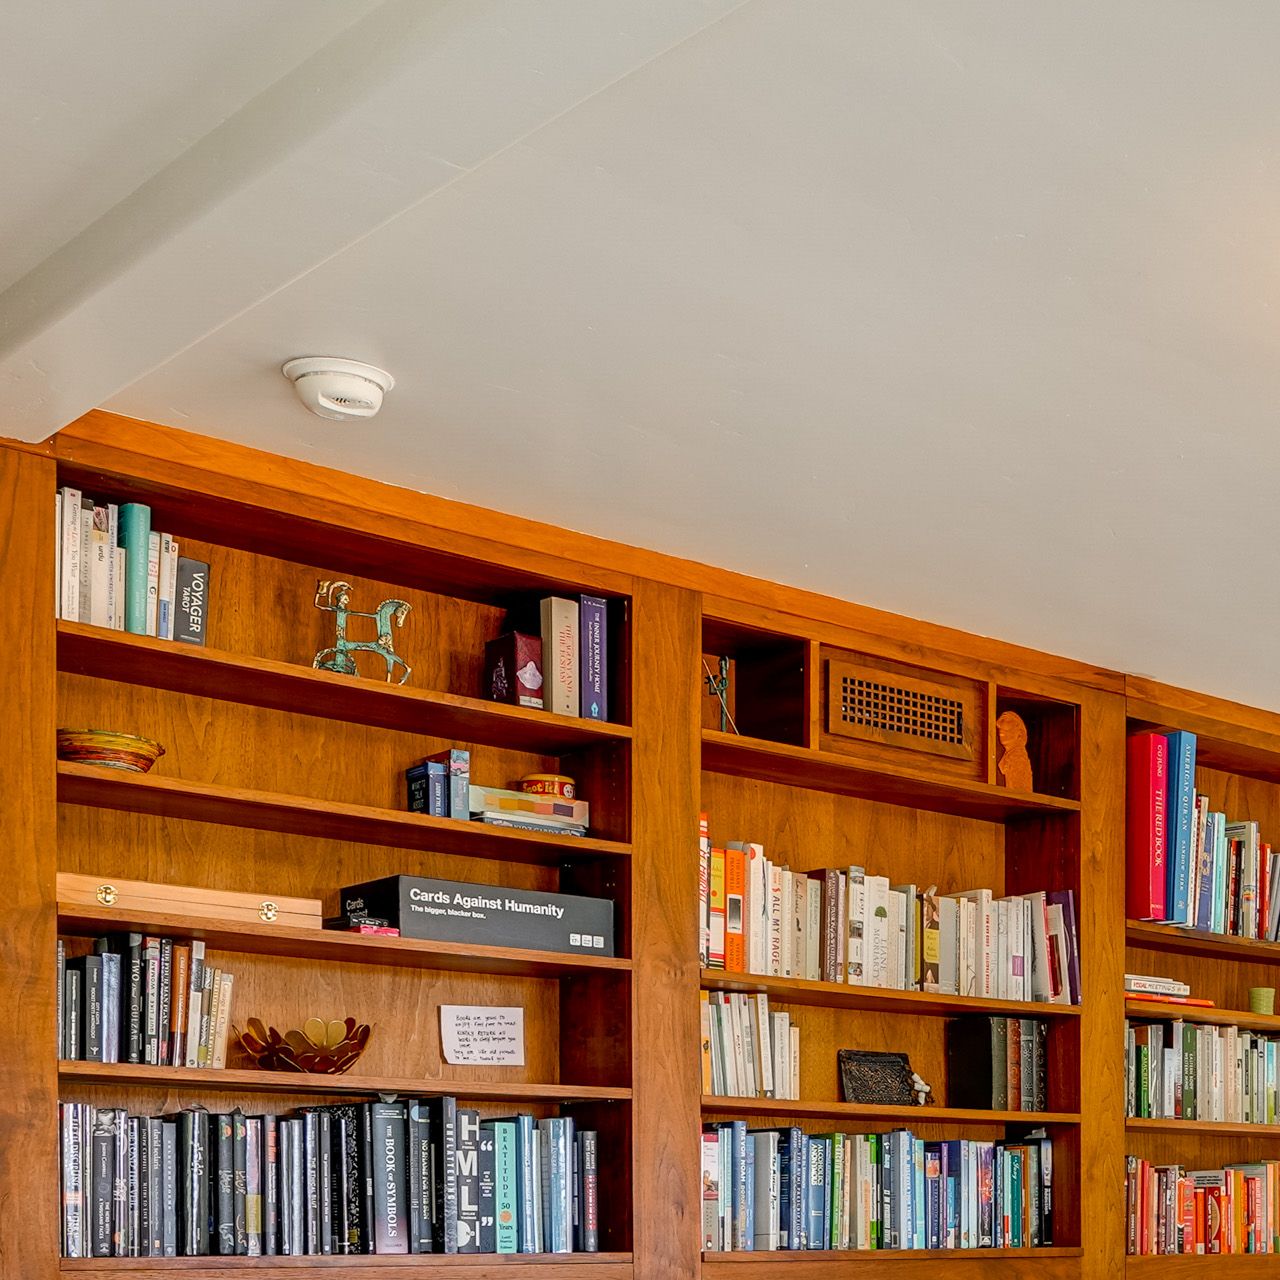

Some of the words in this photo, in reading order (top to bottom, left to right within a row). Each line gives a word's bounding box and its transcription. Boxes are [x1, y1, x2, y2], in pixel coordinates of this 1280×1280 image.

[182, 587, 190, 613] TAROT
[189, 572, 205, 633] VOYAGER
[593, 623, 601, 643] INNER
[1183, 744, 1192, 793] AMERICAN
[1155, 789, 1163, 812] THE
[345, 898, 364, 911] Cards
[409, 887, 450, 904] Cards
[453, 892, 503, 911] Against
[505, 899, 565, 919] Humanity
[410, 904, 424, 913] The
[424, 905, 447, 916] bigger,
[447, 908, 470, 918] blacker
[470, 911, 487, 920] box.
[772, 895, 780, 914] ALL
[772, 918, 780, 933] MY
[771, 937, 780, 965] RAGE
[872, 928, 880, 981] MORIARTY
[131, 959, 140, 981] TWO
[1148, 983, 1176, 992] MEETINGS
[131, 1004, 140, 1041] GULZAR
[72, 1118, 80, 1143] FIFTH
[153, 1128, 161, 1147] david
[461, 1115, 480, 1141] H
[385, 1138, 396, 1172] BOOK
[421, 1139, 428, 1150] NO
[71, 1144, 80, 1186] DISCIPLINE
[153, 1147, 161, 1170] sedaris
[421, 1151, 429, 1175] SHAME
[446, 1123, 455, 1200] UNFLATTENING
[456, 1150, 478, 1176] M
[387, 1172, 393, 1182] OF
[386, 1182, 398, 1237] SYMBOLS
[461, 1185, 478, 1212] L
[501, 1202, 511, 1210] 50
